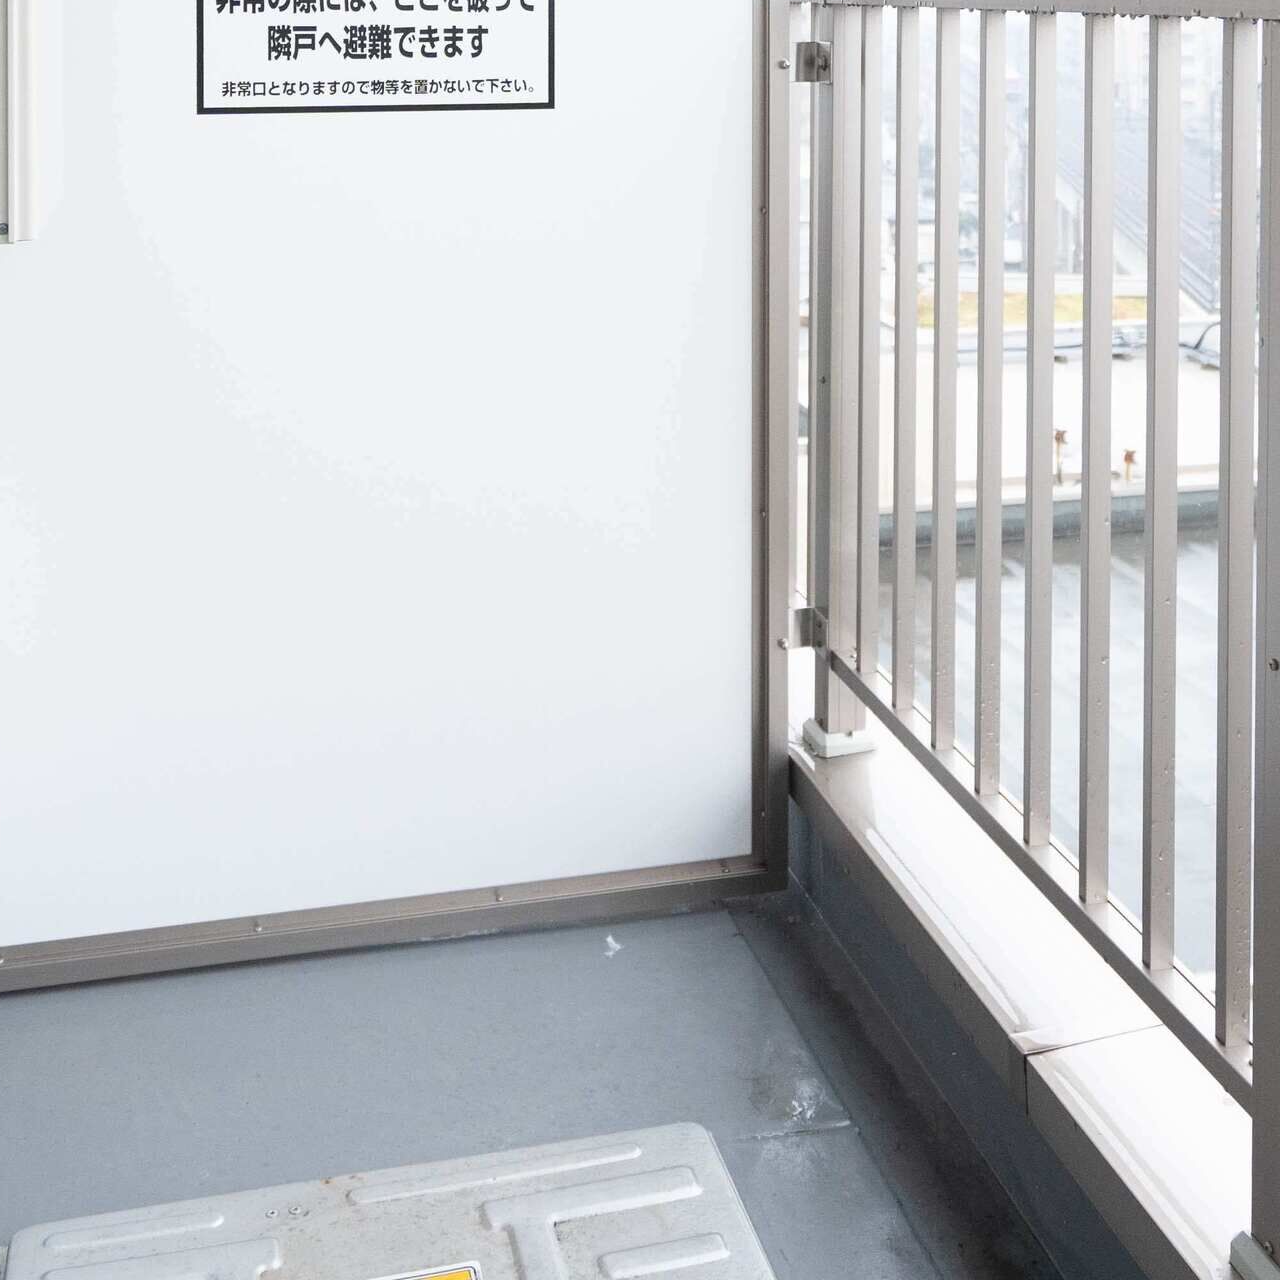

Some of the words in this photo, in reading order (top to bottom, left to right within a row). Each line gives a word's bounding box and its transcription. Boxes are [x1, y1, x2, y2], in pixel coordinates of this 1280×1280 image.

[266, 24, 489, 61] 隣戸へ避難できます
[221, 78, 535, 97] 非常口となりますので物等を置かないで下さい。
